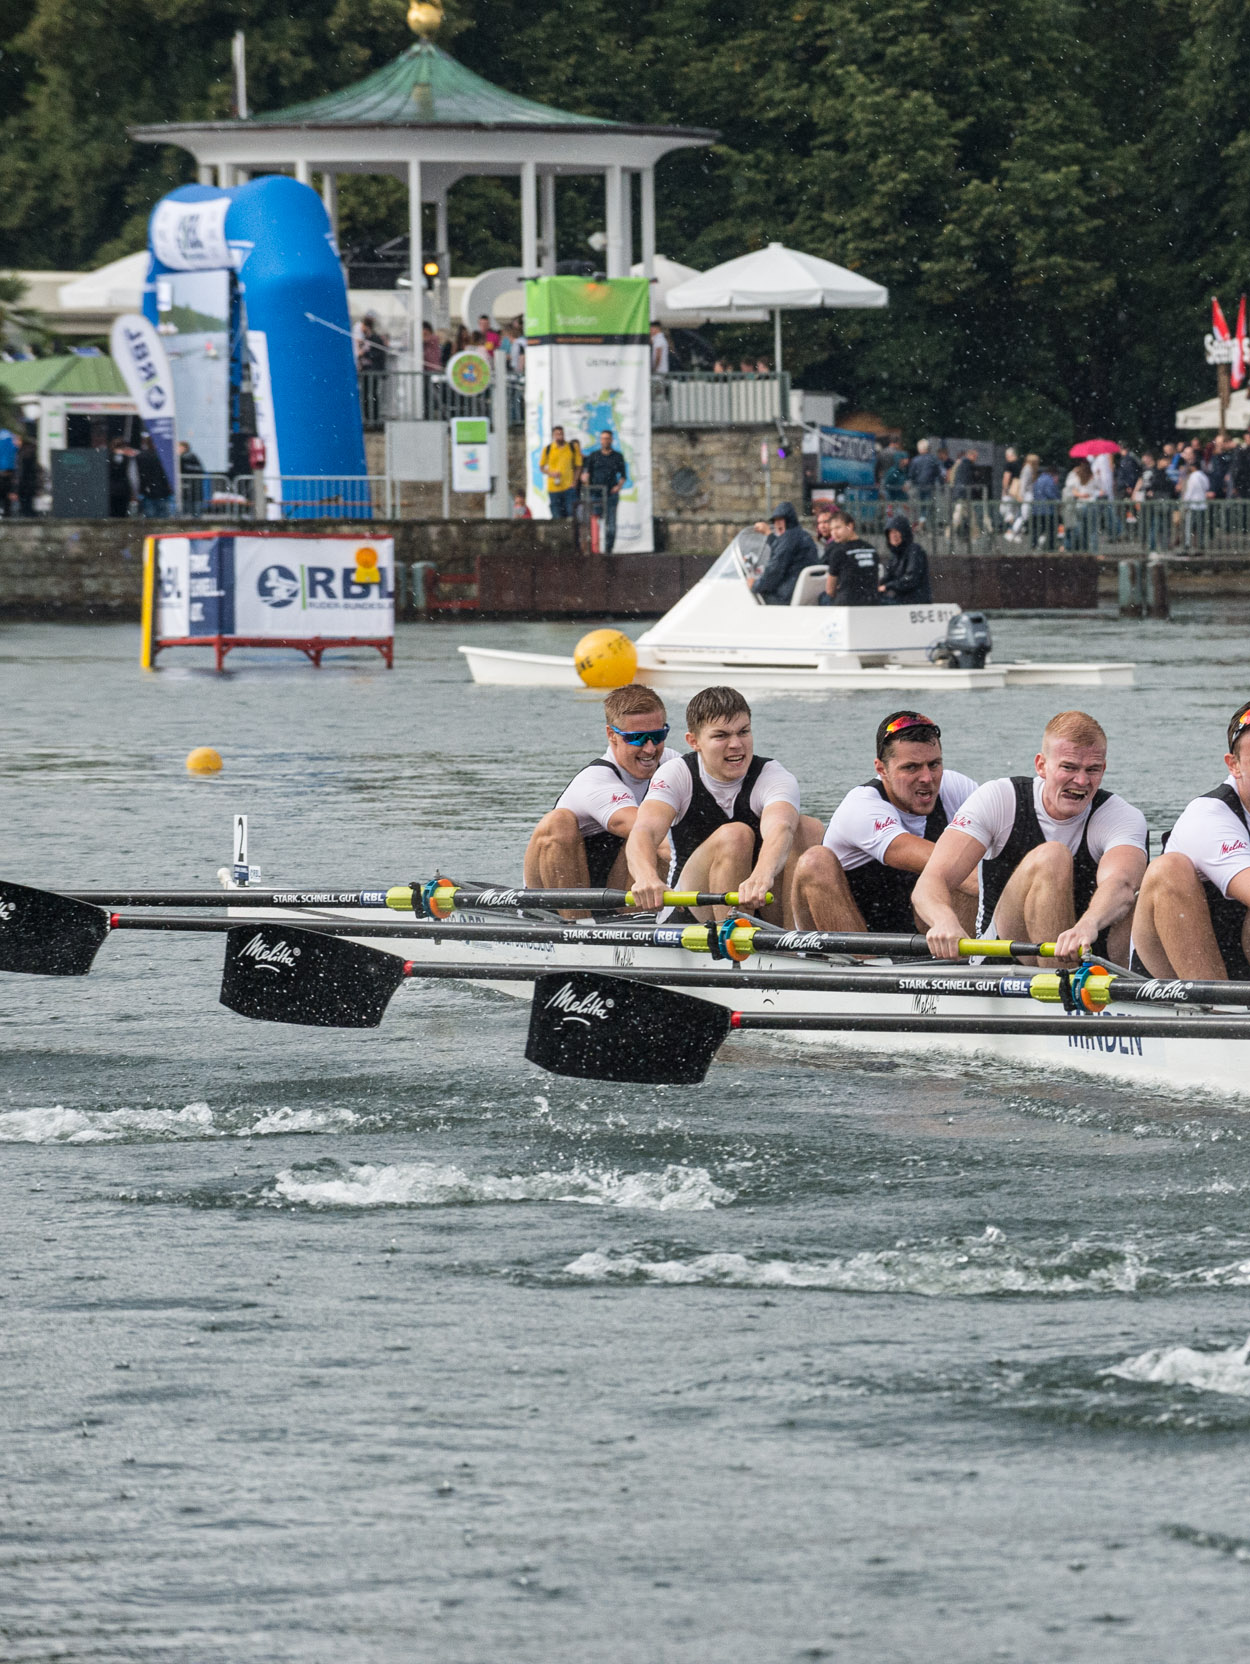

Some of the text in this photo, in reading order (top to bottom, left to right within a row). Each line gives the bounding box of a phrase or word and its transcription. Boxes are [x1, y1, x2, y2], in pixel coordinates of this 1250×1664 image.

[308, 566, 394, 599] RBL
[238, 816, 245, 862] 2
[273, 892, 385, 904] STARK. SCHNELL. GUT. RBL
[238, 932, 297, 967] Melitta
[563, 929, 680, 941] STARK. SCHNELL. GUT. RBL
[544, 982, 609, 1020] Melitta
[899, 978, 1029, 992] STARK. SCHNELL. GUT. RBL
